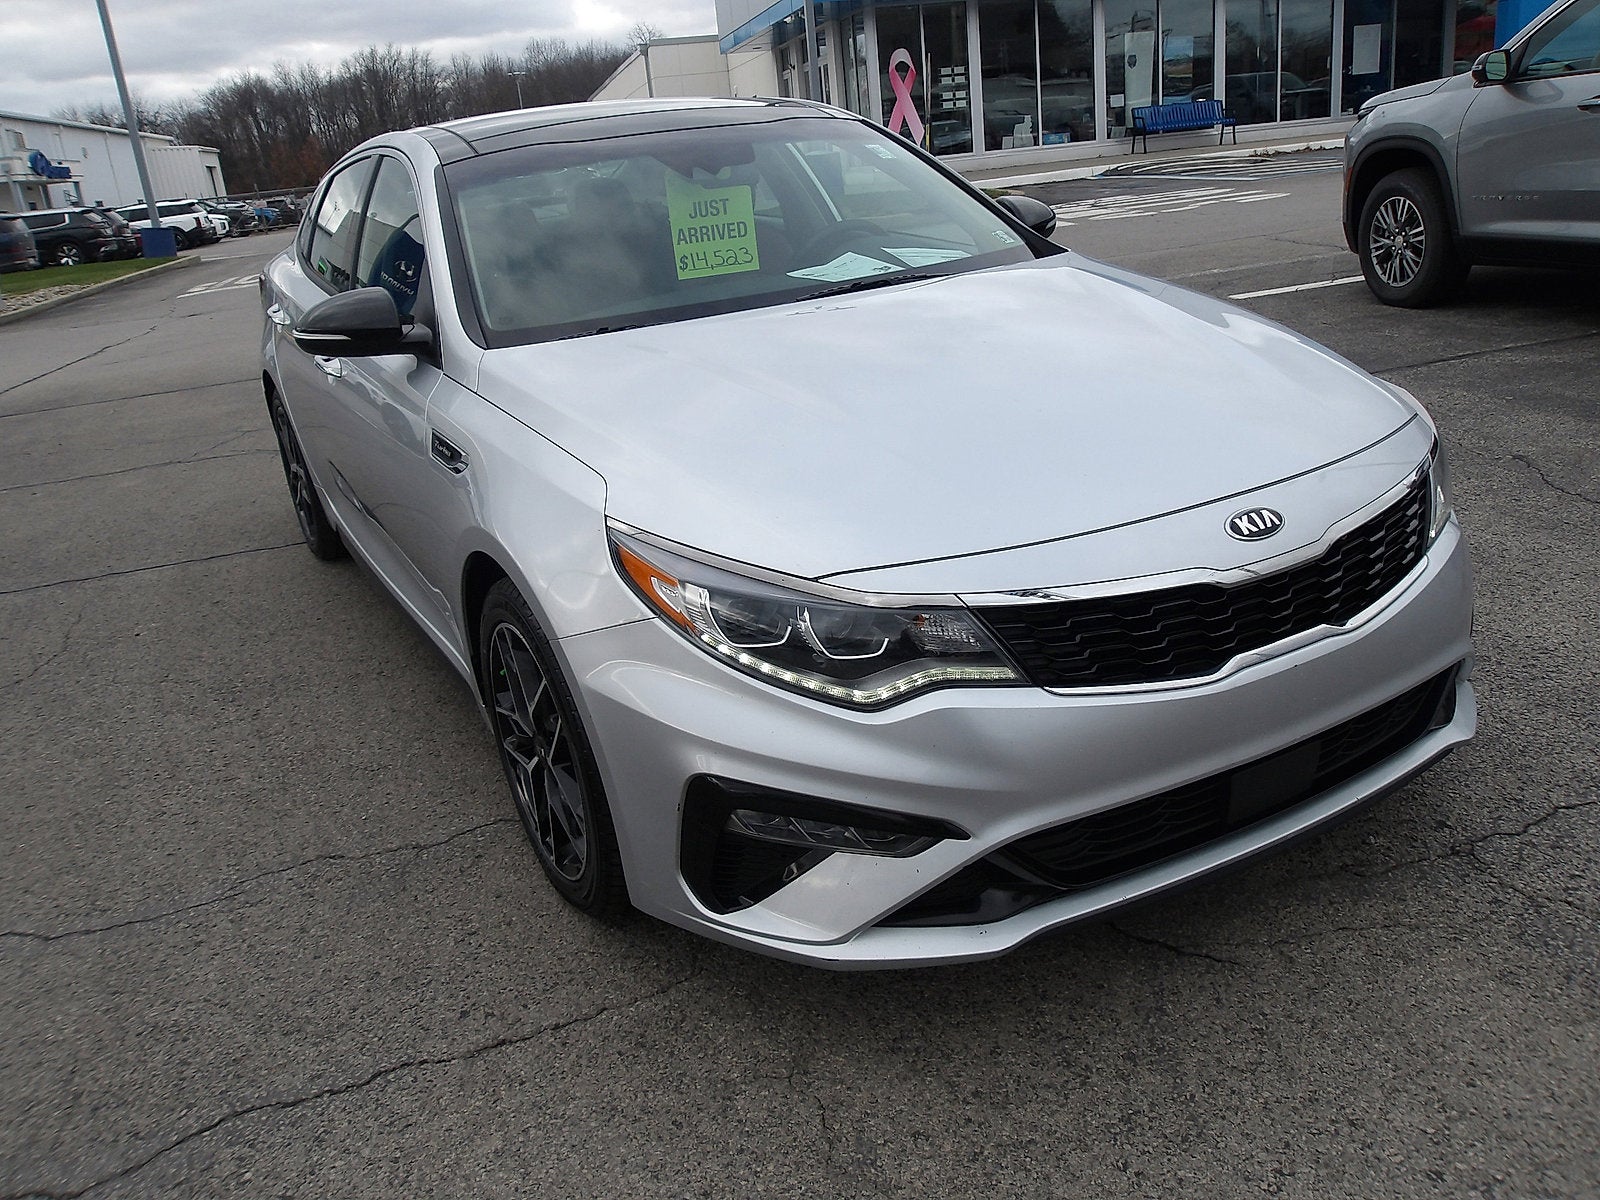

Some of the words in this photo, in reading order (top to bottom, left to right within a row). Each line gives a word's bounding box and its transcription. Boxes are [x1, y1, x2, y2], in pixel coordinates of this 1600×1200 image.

[689, 198, 728, 219] JUST
[677, 221, 748, 245] ARRIVED
[679, 247, 753, 272] $14,523
[1232, 509, 1281, 536] KIA
